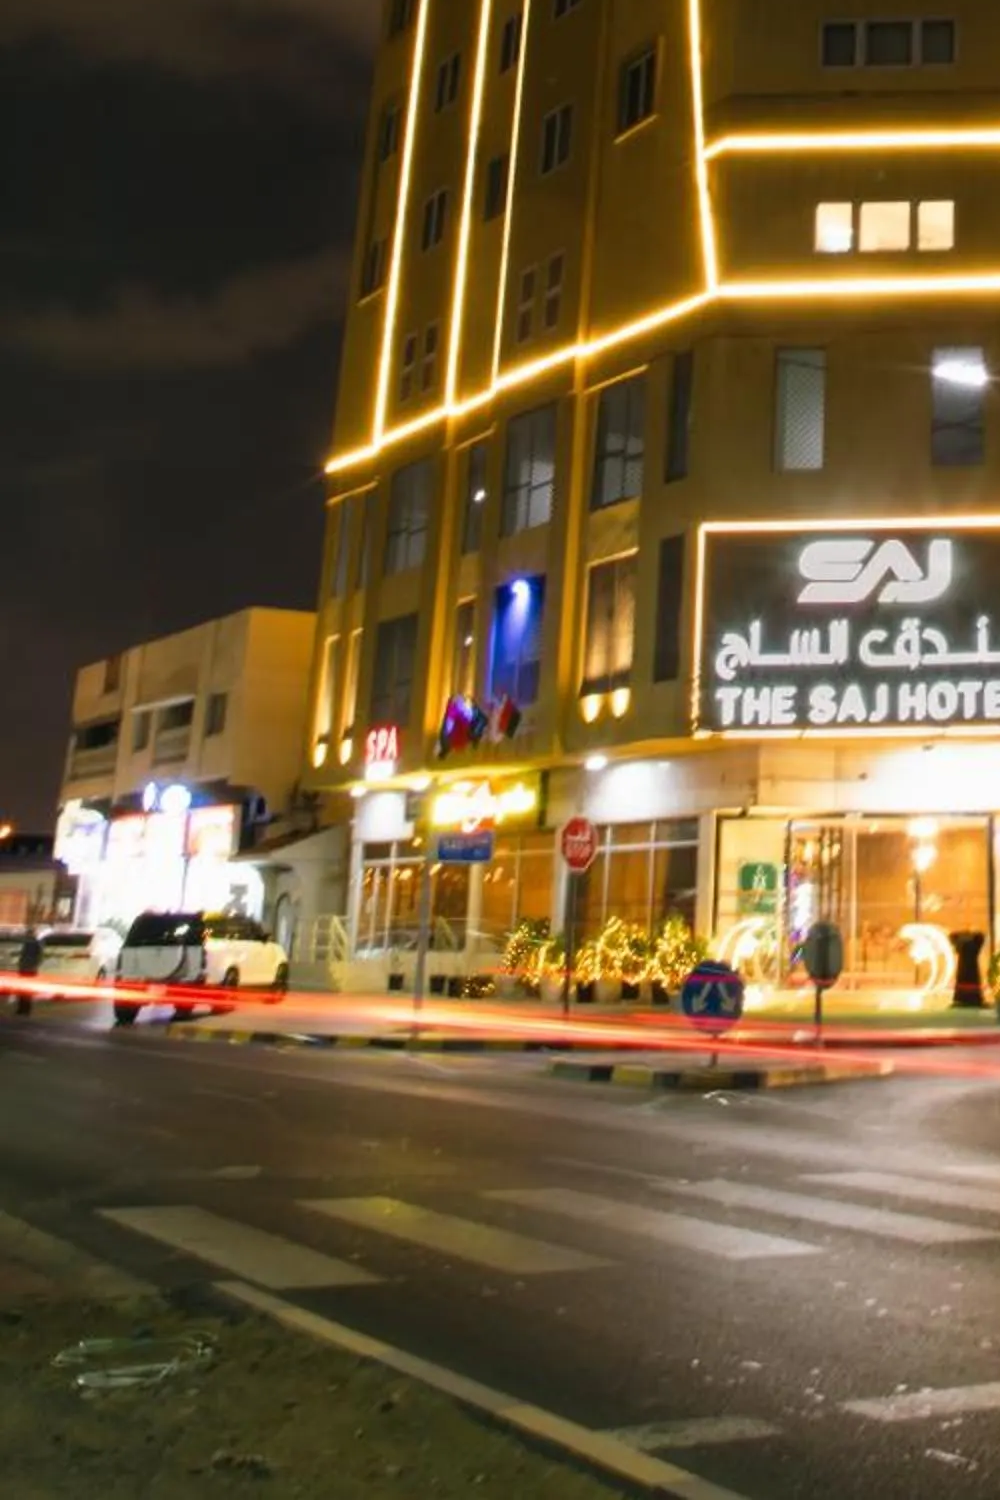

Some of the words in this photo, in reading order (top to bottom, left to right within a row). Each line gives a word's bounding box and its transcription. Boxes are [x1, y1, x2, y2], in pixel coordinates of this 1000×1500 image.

[797, 539, 952, 603] SAJ
[714, 618, 849, 681] الساج
[714, 685, 798, 726] THE
[808, 682, 889, 724] SAJ
[364, 725, 399, 765] SPA
